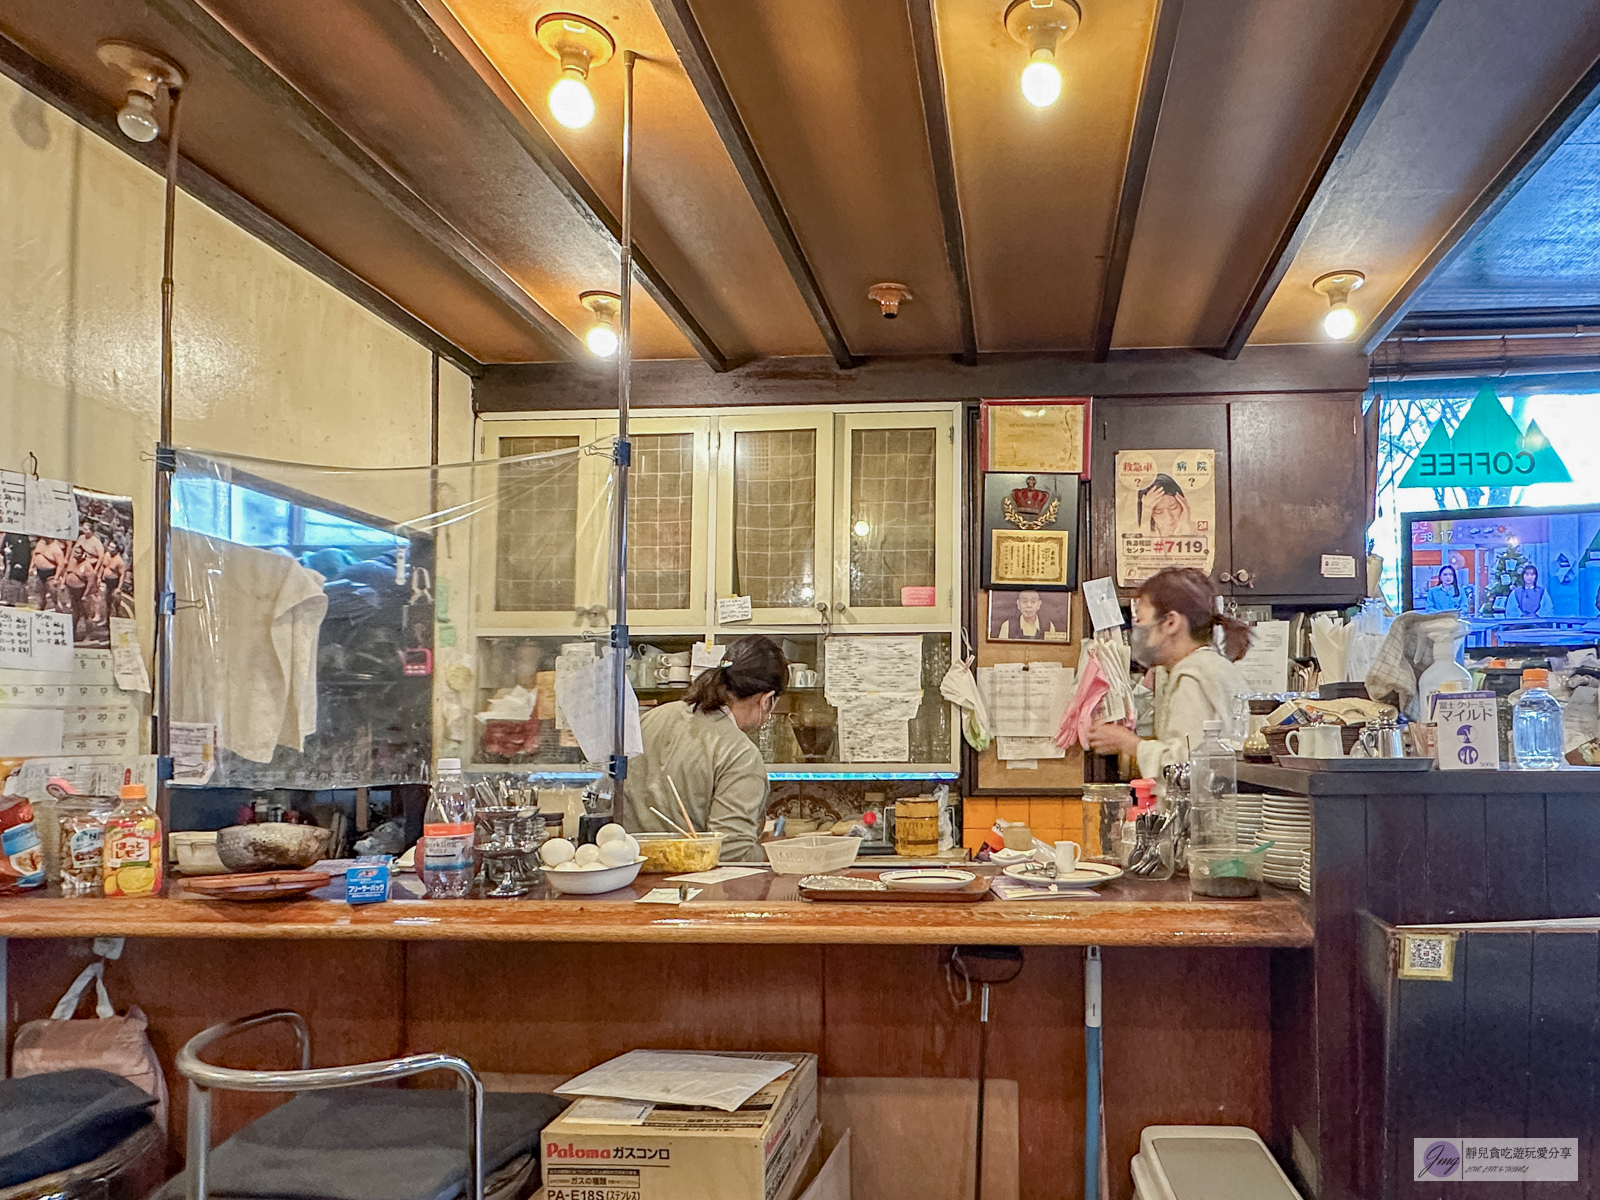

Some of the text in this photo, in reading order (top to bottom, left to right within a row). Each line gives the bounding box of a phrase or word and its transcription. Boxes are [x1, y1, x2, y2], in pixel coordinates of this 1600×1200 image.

[1176, 461, 1207, 472] 病院
[1188, 478, 1195, 487] ?
[1153, 540, 1203, 553] #7119
[1439, 709, 1493, 722] マイルド
[115, 841, 144, 850] ほっと
[115, 850, 146, 859] レモン
[546, 1143, 670, 1160] Paloma ガスコンロ
[547, 1189, 604, 1200] PA-E18S
